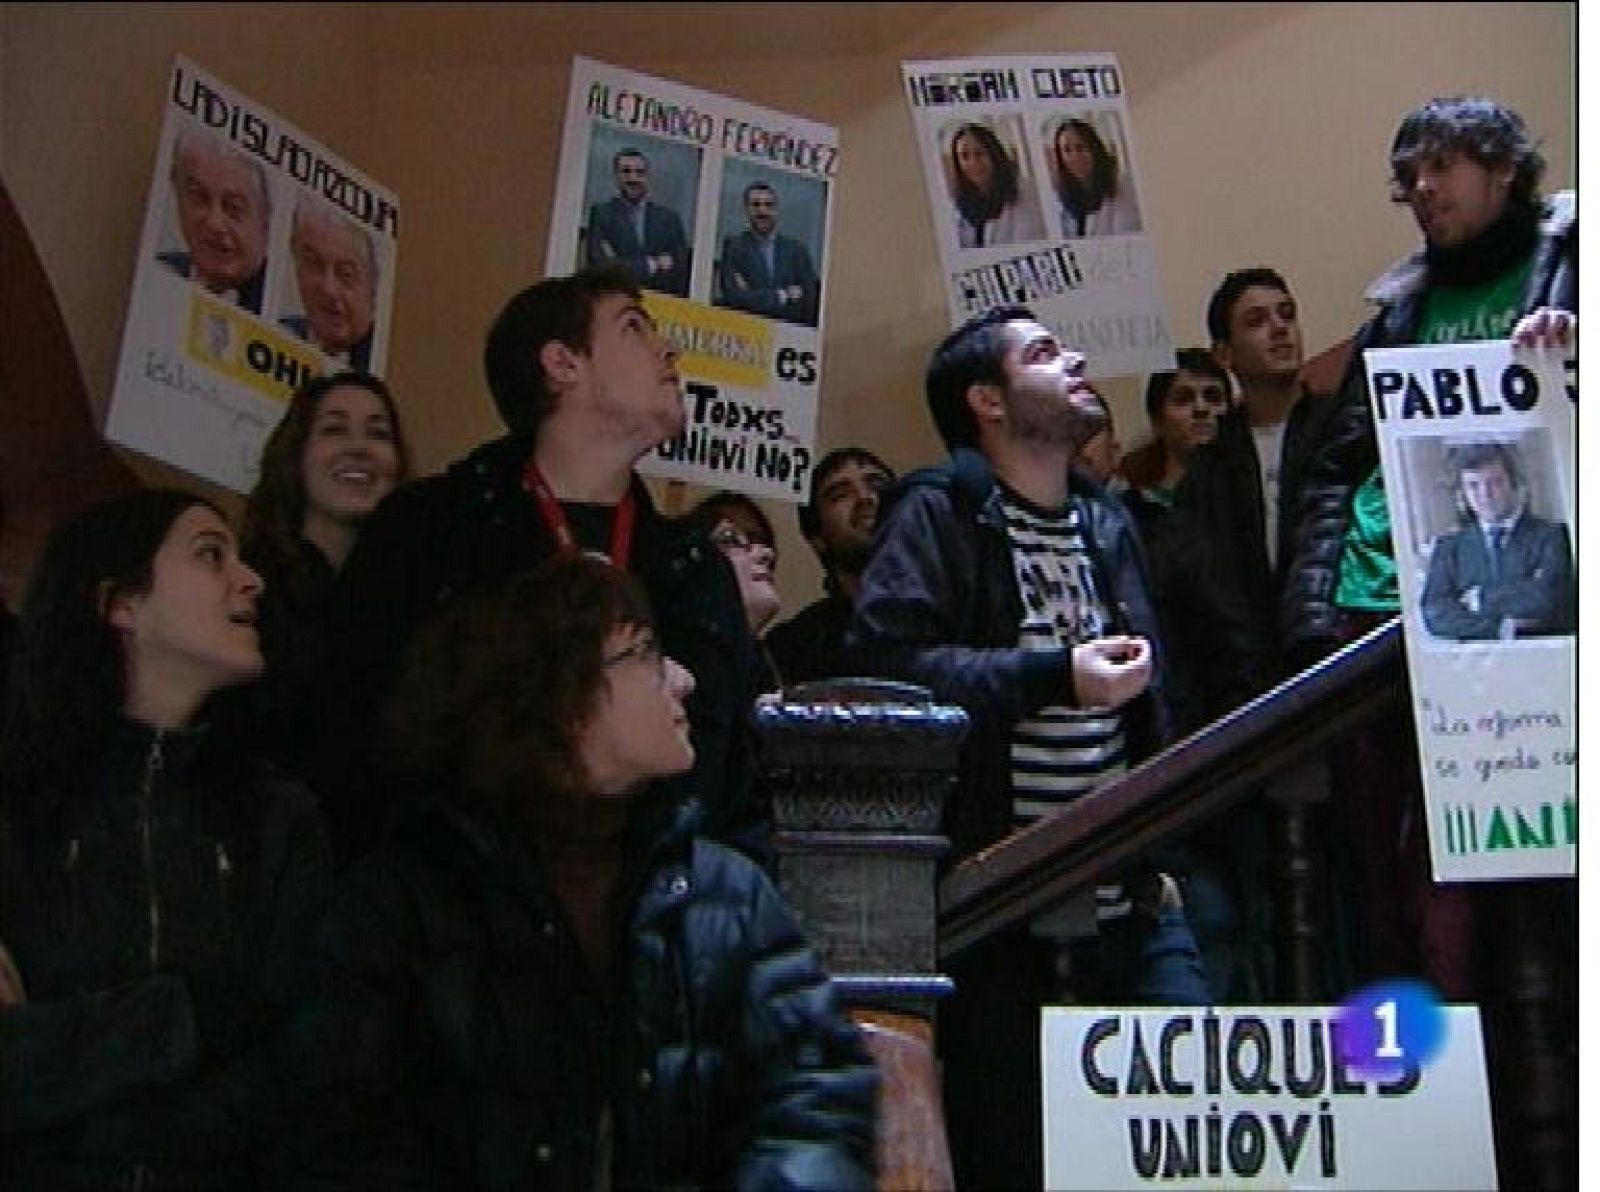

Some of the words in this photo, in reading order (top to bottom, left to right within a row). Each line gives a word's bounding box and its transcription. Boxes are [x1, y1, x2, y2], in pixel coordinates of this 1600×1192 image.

[1030, 64, 1122, 99] CUETO
[587, 80, 714, 144] ALEJANDRO
[776, 347, 818, 384] es
[1373, 364, 1538, 419] PABLO
[755, 442, 811, 492] NO?
[1128, 1099, 1337, 1179] UNIOVI
